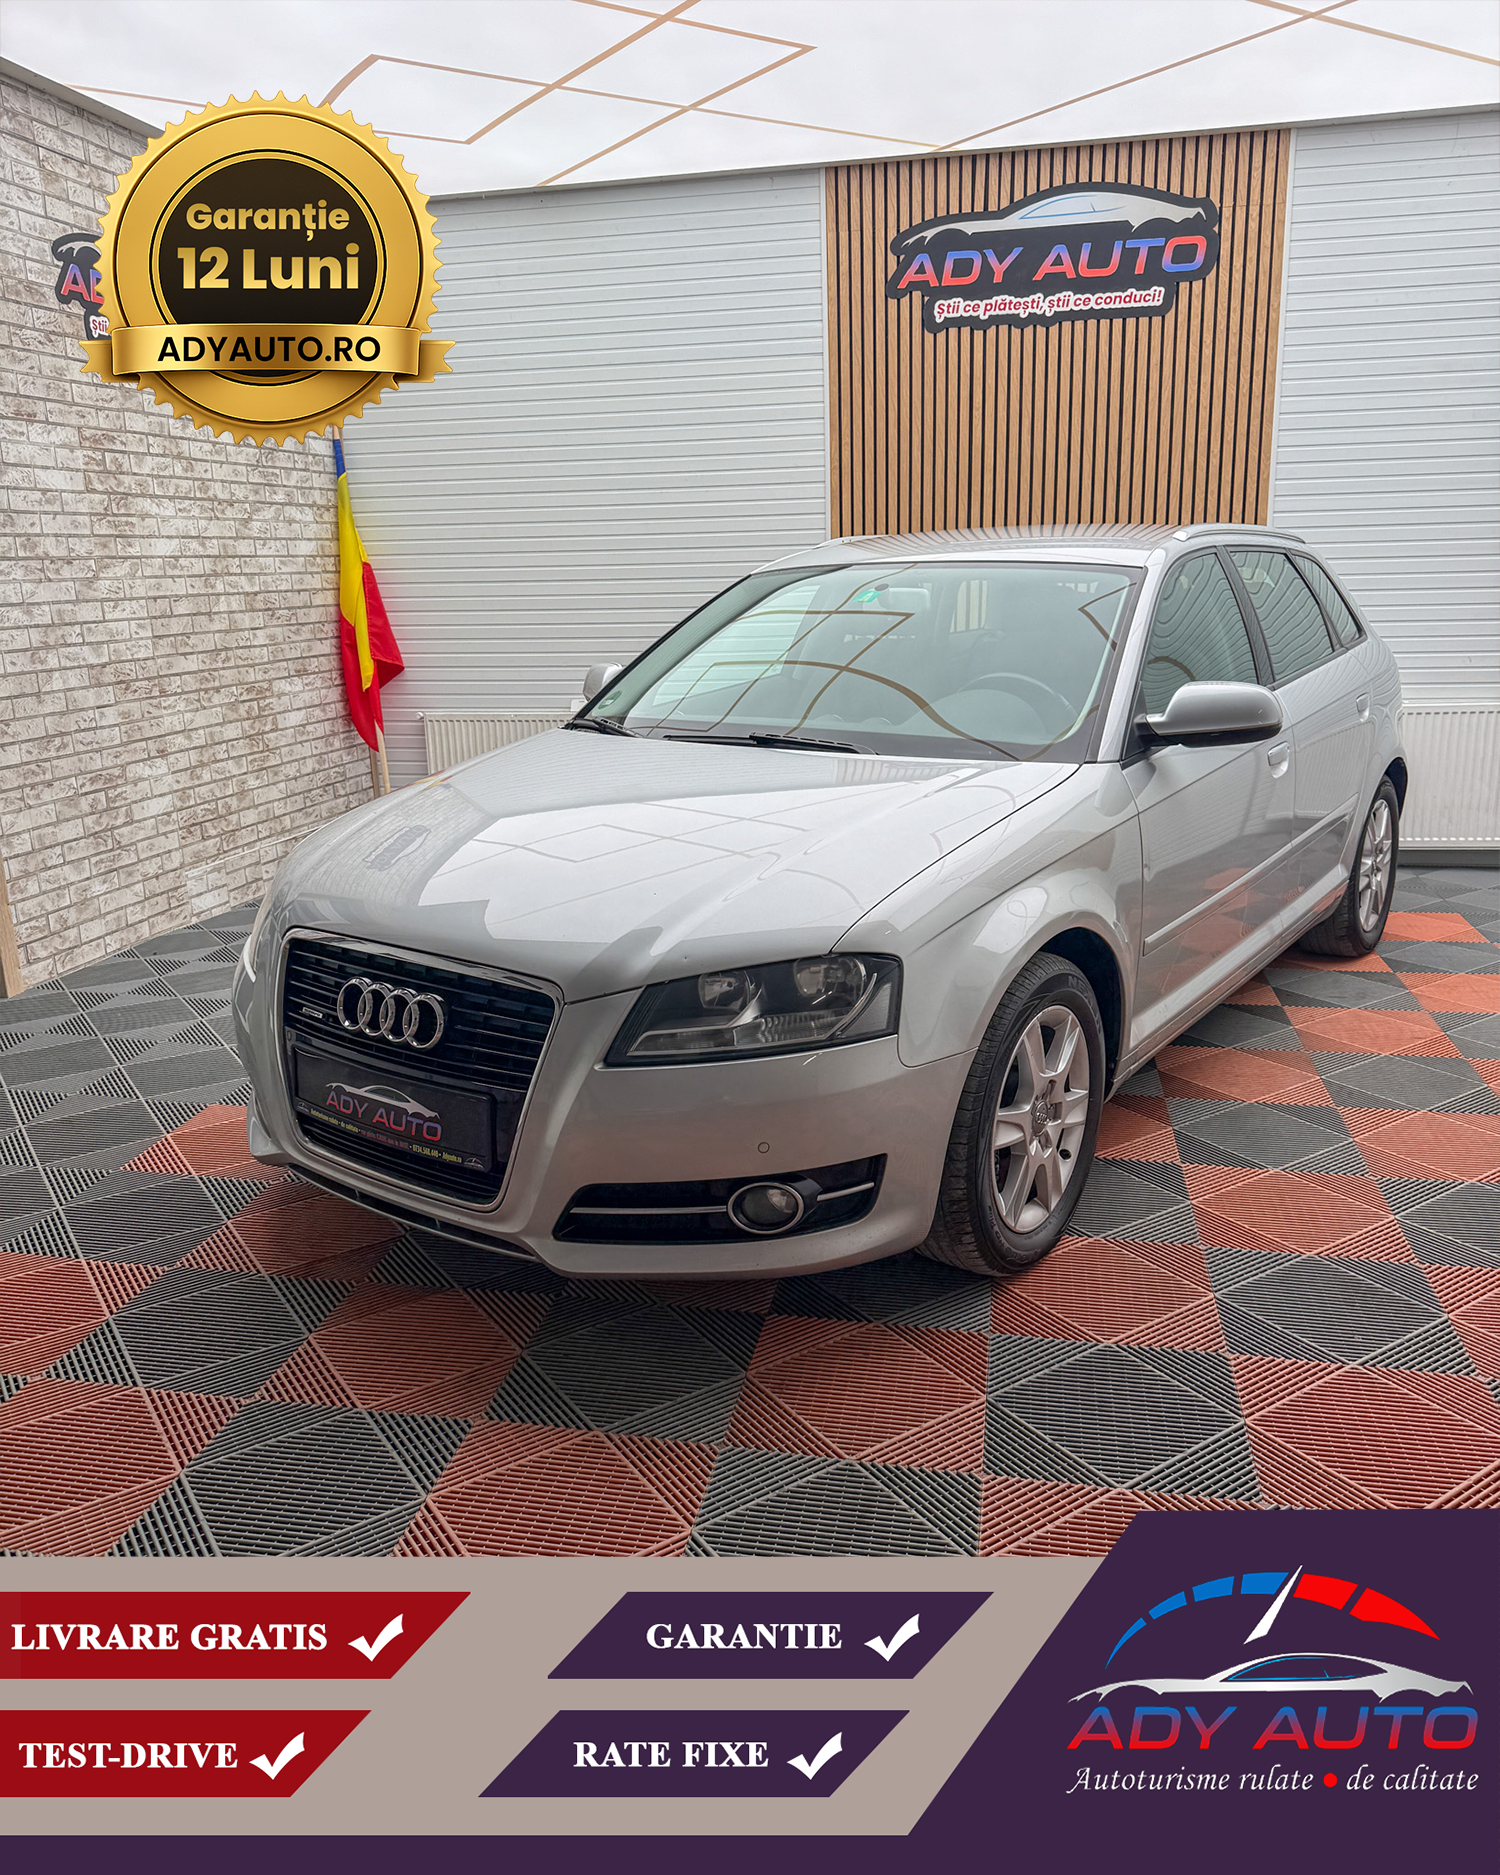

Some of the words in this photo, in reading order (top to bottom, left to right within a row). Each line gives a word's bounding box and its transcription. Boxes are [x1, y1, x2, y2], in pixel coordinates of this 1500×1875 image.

[897, 247, 1023, 289] ADY
[1033, 235, 1207, 281] AUTO
[937, 301, 961, 319] Știi
[963, 303, 981, 313] ce
[983, 297, 1043, 316] plătești,
[1048, 295, 1071, 313] știi
[1073, 297, 1091, 306] ce
[1094, 289, 1162, 306] conduci!
[326, 1091, 368, 1118] ADY
[372, 1107, 442, 1142] AUTO
